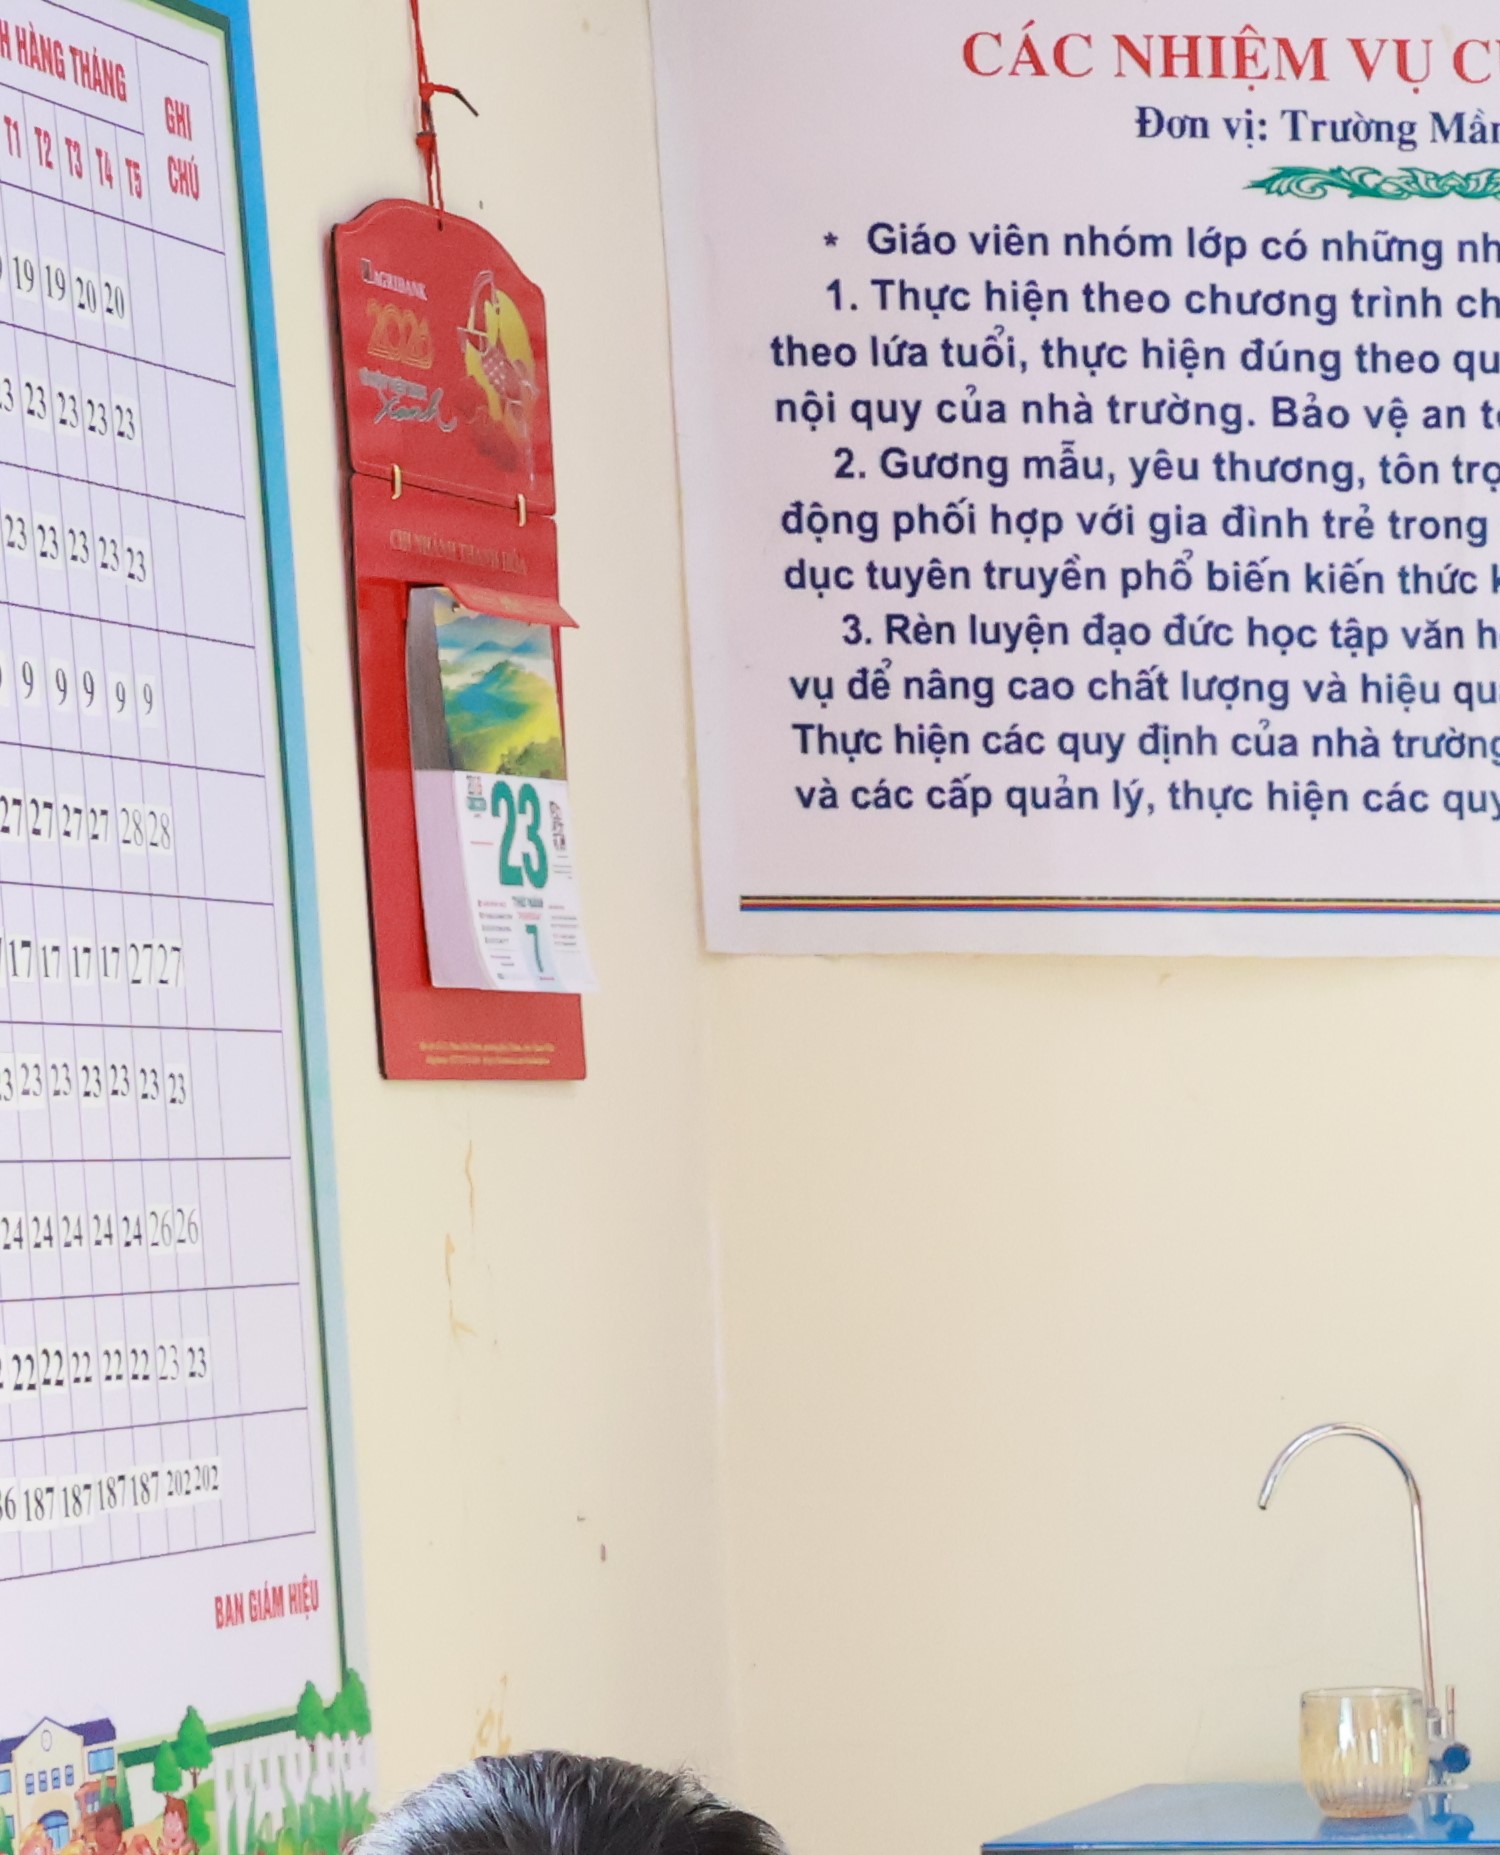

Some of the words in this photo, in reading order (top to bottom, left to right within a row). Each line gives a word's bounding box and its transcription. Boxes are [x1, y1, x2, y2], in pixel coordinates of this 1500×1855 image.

[15, 21, 66, 81] HÀNG
[69, 46, 127, 102] THÁNG
[962, 19, 1094, 78] CÁC
[1112, 23, 1330, 92] NHIỆM
[1346, 37, 1433, 95] VỤ
[164, 95, 193, 142] GHI
[1134, 105, 1210, 140] Đơn
[1222, 107, 1268, 150] vị:
[1280, 109, 1418, 153] Trường
[4, 115, 21, 158] T1
[34, 127, 53, 170] T2
[65, 136, 84, 180] T3
[95, 147, 114, 190] T4
[125, 157, 143, 199] T5
[167, 154, 200, 201] CHÚ
[866, 221, 957, 256] Giáo
[968, 222, 1050, 257] viên
[1063, 224, 1173, 258] nhóm
[1186, 225, 1248, 268] lớp
[1260, 227, 1308, 262] có
[1321, 229, 1443, 272] những
[12, 255, 35, 293] 19
[45, 263, 67, 302] 19
[75, 276, 97, 314] 20
[104, 281, 126, 319] 20
[826, 278, 858, 312] 1.
[869, 278, 971, 321] Thực
[984, 279, 1069, 322] hiện
[1081, 280, 1171, 314] theo
[1184, 282, 1338, 327] chương
[1350, 285, 1443, 319] trình
[769, 333, 858, 368] theo
[870, 333, 929, 368] lứa
[940, 324, 1028, 375] tuổi,
[1040, 336, 1128, 378] thực
[1141, 336, 1226, 380] hiện
[1239, 337, 1342, 383] đúng
[1354, 341, 1441, 375] theo
[775, 389, 836, 433] nội
[849, 398, 923, 433] quy
[935, 383, 1007, 424] của
[1021, 391, 1094, 425] nhà
[1106, 391, 1256, 436] trường.
[1271, 391, 1351, 430] Bảo
[1362, 396, 1409, 439] vệ
[1422, 404, 1466, 430] an
[4, 514, 27, 550] 23
[37, 524, 59, 561] 23
[68, 528, 90, 564] 23
[98, 536, 120, 572] 23
[126, 546, 147, 584] 23
[30, 797, 54, 837] 27
[62, 802, 83, 839] 27
[89, 807, 110, 842] 27
[120, 807, 144, 847] 28
[148, 810, 172, 851] 28
[794, 776, 840, 810] và
[850, 777, 914, 811] các
[925, 772, 993, 818] cấp
[1005, 773, 1099, 818] quản
[1112, 778, 1155, 819] lý,
[1167, 778, 1254, 819] thực
[1267, 779, 1349, 821] hiện
[1362, 780, 1430, 814] các
[491, 780, 549, 889] 23
[2, 1215, 24, 1251] 24
[32, 1215, 54, 1249] 24
[62, 1213, 84, 1248] 24
[93, 1212, 114, 1247] 24
[123, 1215, 143, 1248] 24
[149, 1210, 173, 1247] 26
[176, 1207, 200, 1246] 26
[23, 1485, 56, 1523] 187
[61, 1484, 92, 1519] 187
[97, 1473, 128, 1511] 187
[130, 1470, 161, 1507] 187
[167, 1469, 192, 1497] 202
[194, 1464, 220, 1492] 202
[214, 1593, 245, 1629] BAN
[248, 1580, 285, 1624] GIÁM
[288, 1574, 320, 1620] HIỆU
